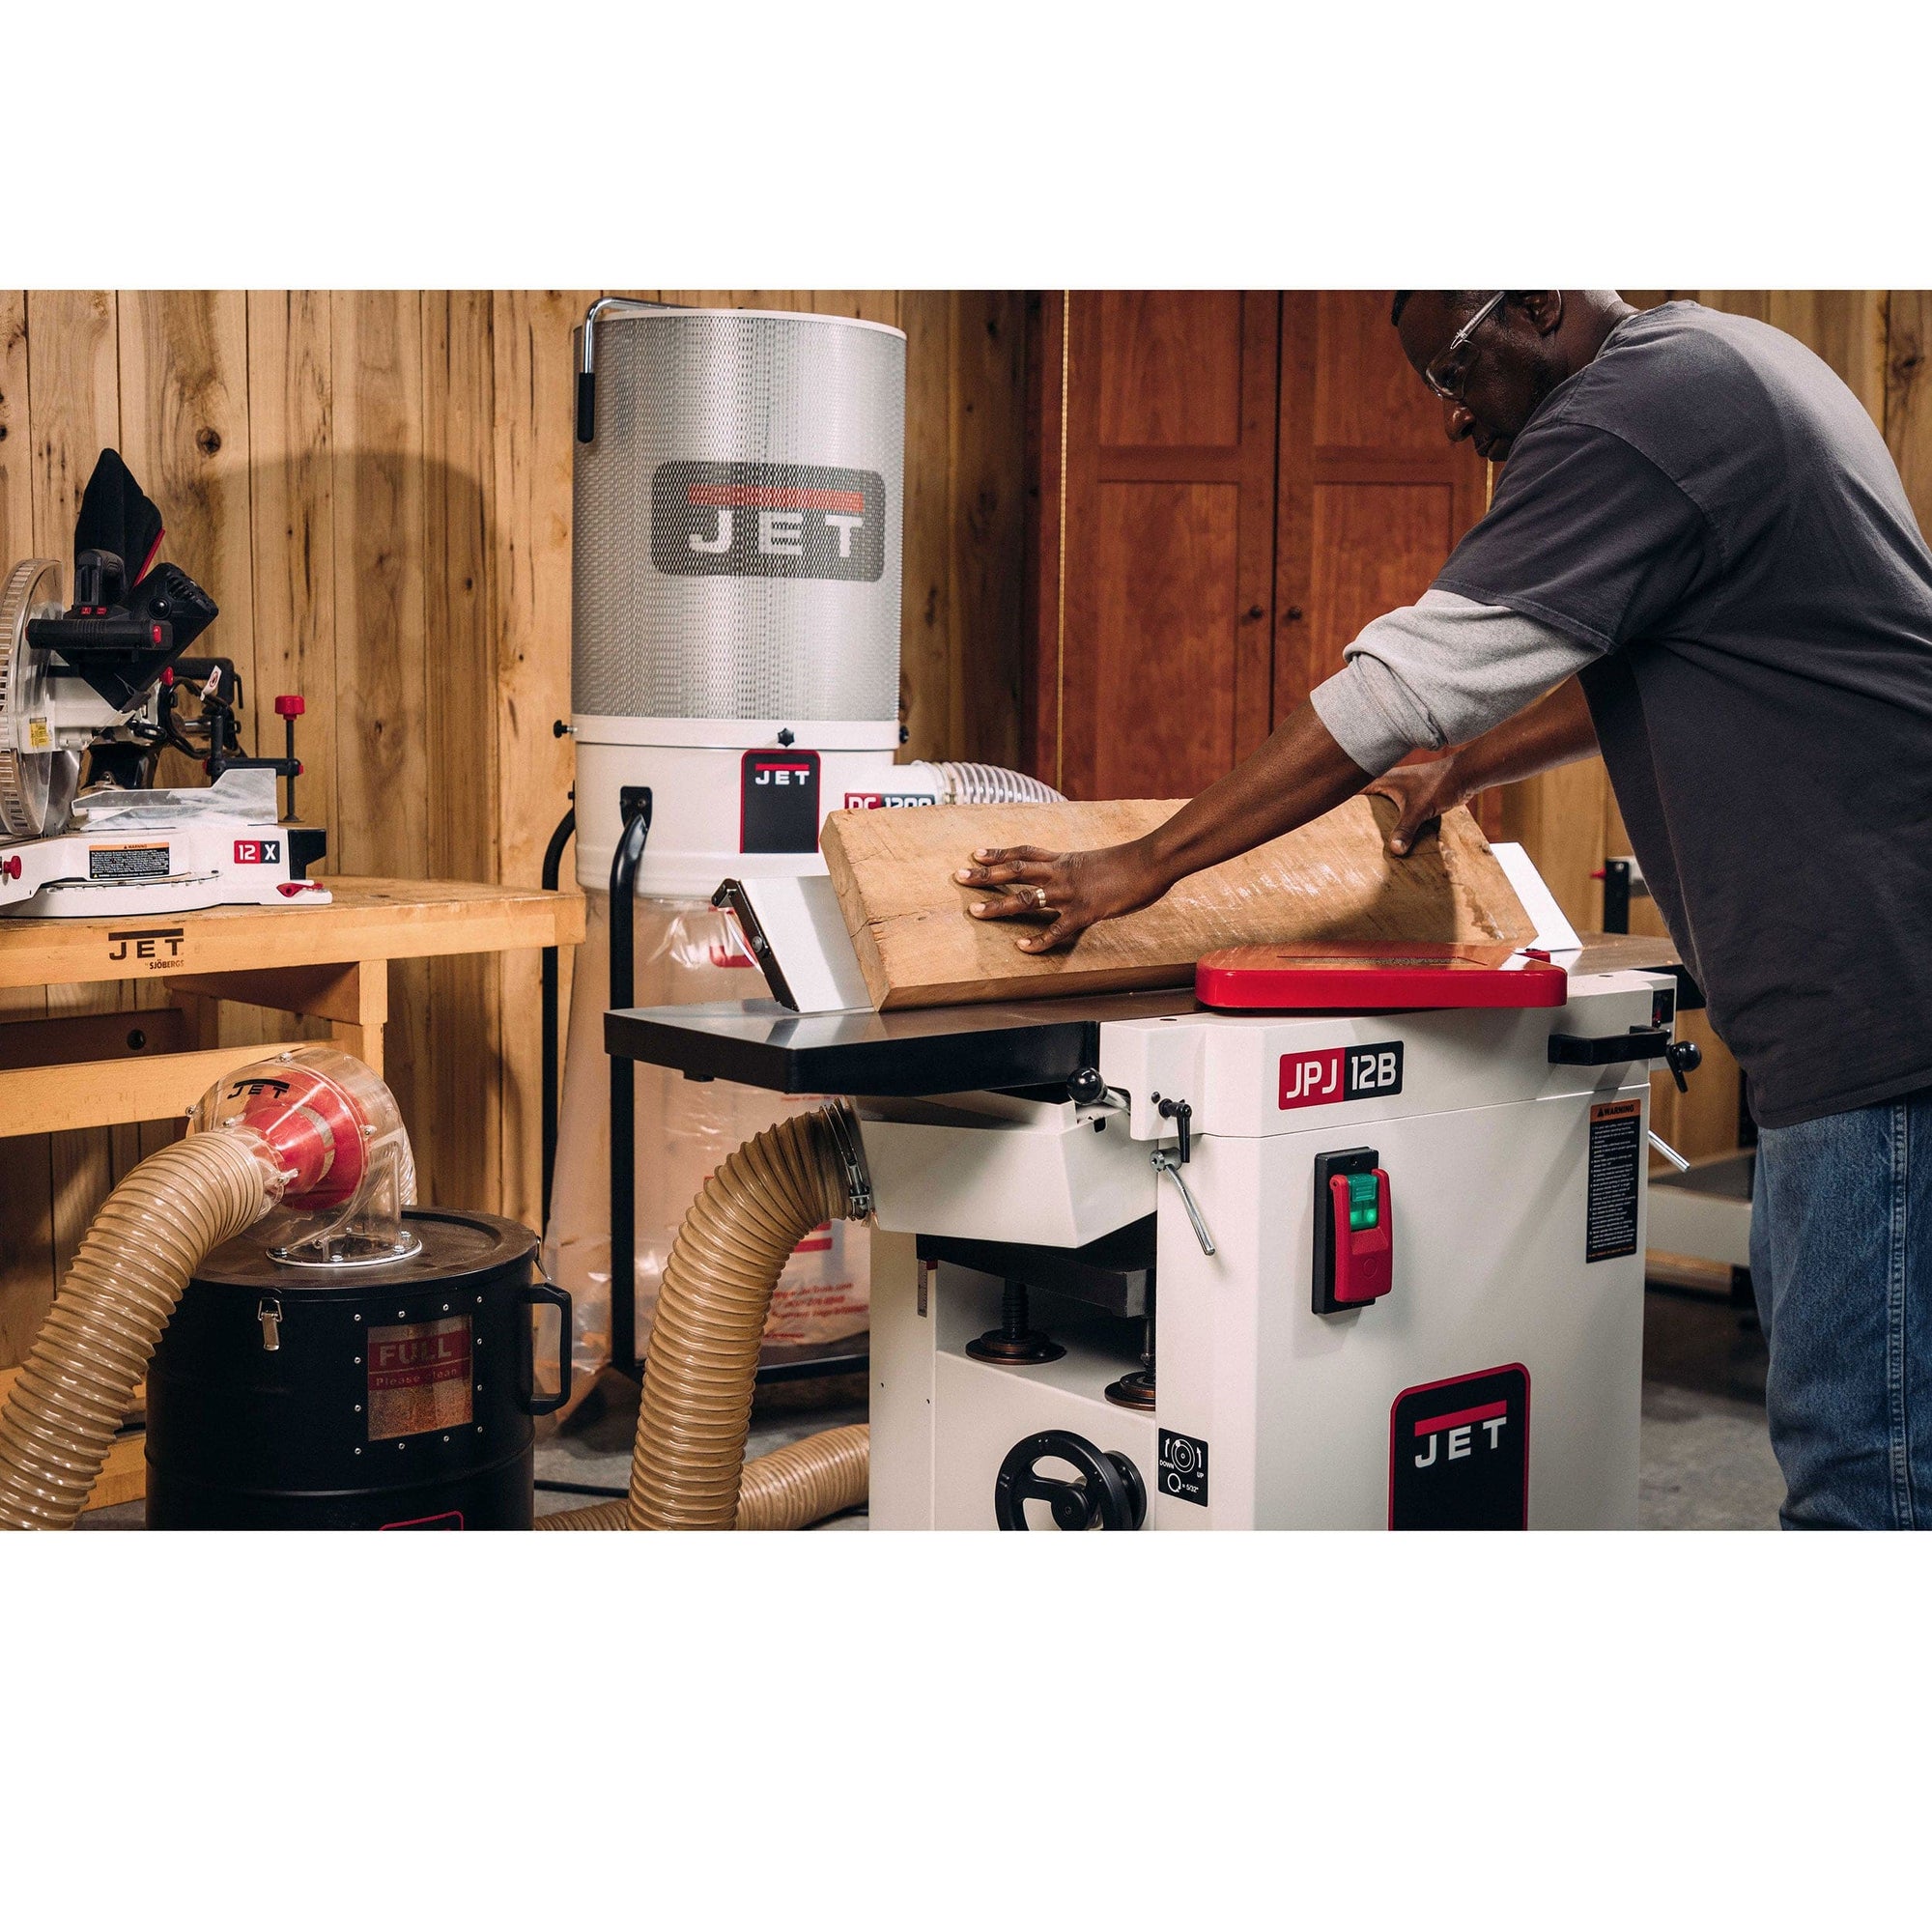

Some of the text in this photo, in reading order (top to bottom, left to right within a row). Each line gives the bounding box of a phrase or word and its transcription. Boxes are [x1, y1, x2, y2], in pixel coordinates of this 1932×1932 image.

[689, 509, 864, 558] JET
[754, 770, 810, 785] JET
[238, 844, 277, 861] 12 X
[108, 937, 185, 961] JET
[149, 959, 185, 970] SJÖBERGS
[1286, 1052, 1397, 1099] JPJ 12B
[227, 1084, 288, 1100] JET
[1604, 1104, 1635, 1116] WARNING
[380, 1337, 453, 1367] FULL
[376, 1375, 421, 1386] Please
[1414, 1416, 1507, 1468] JET
[1159, 1460, 1175, 1469] DOWN
